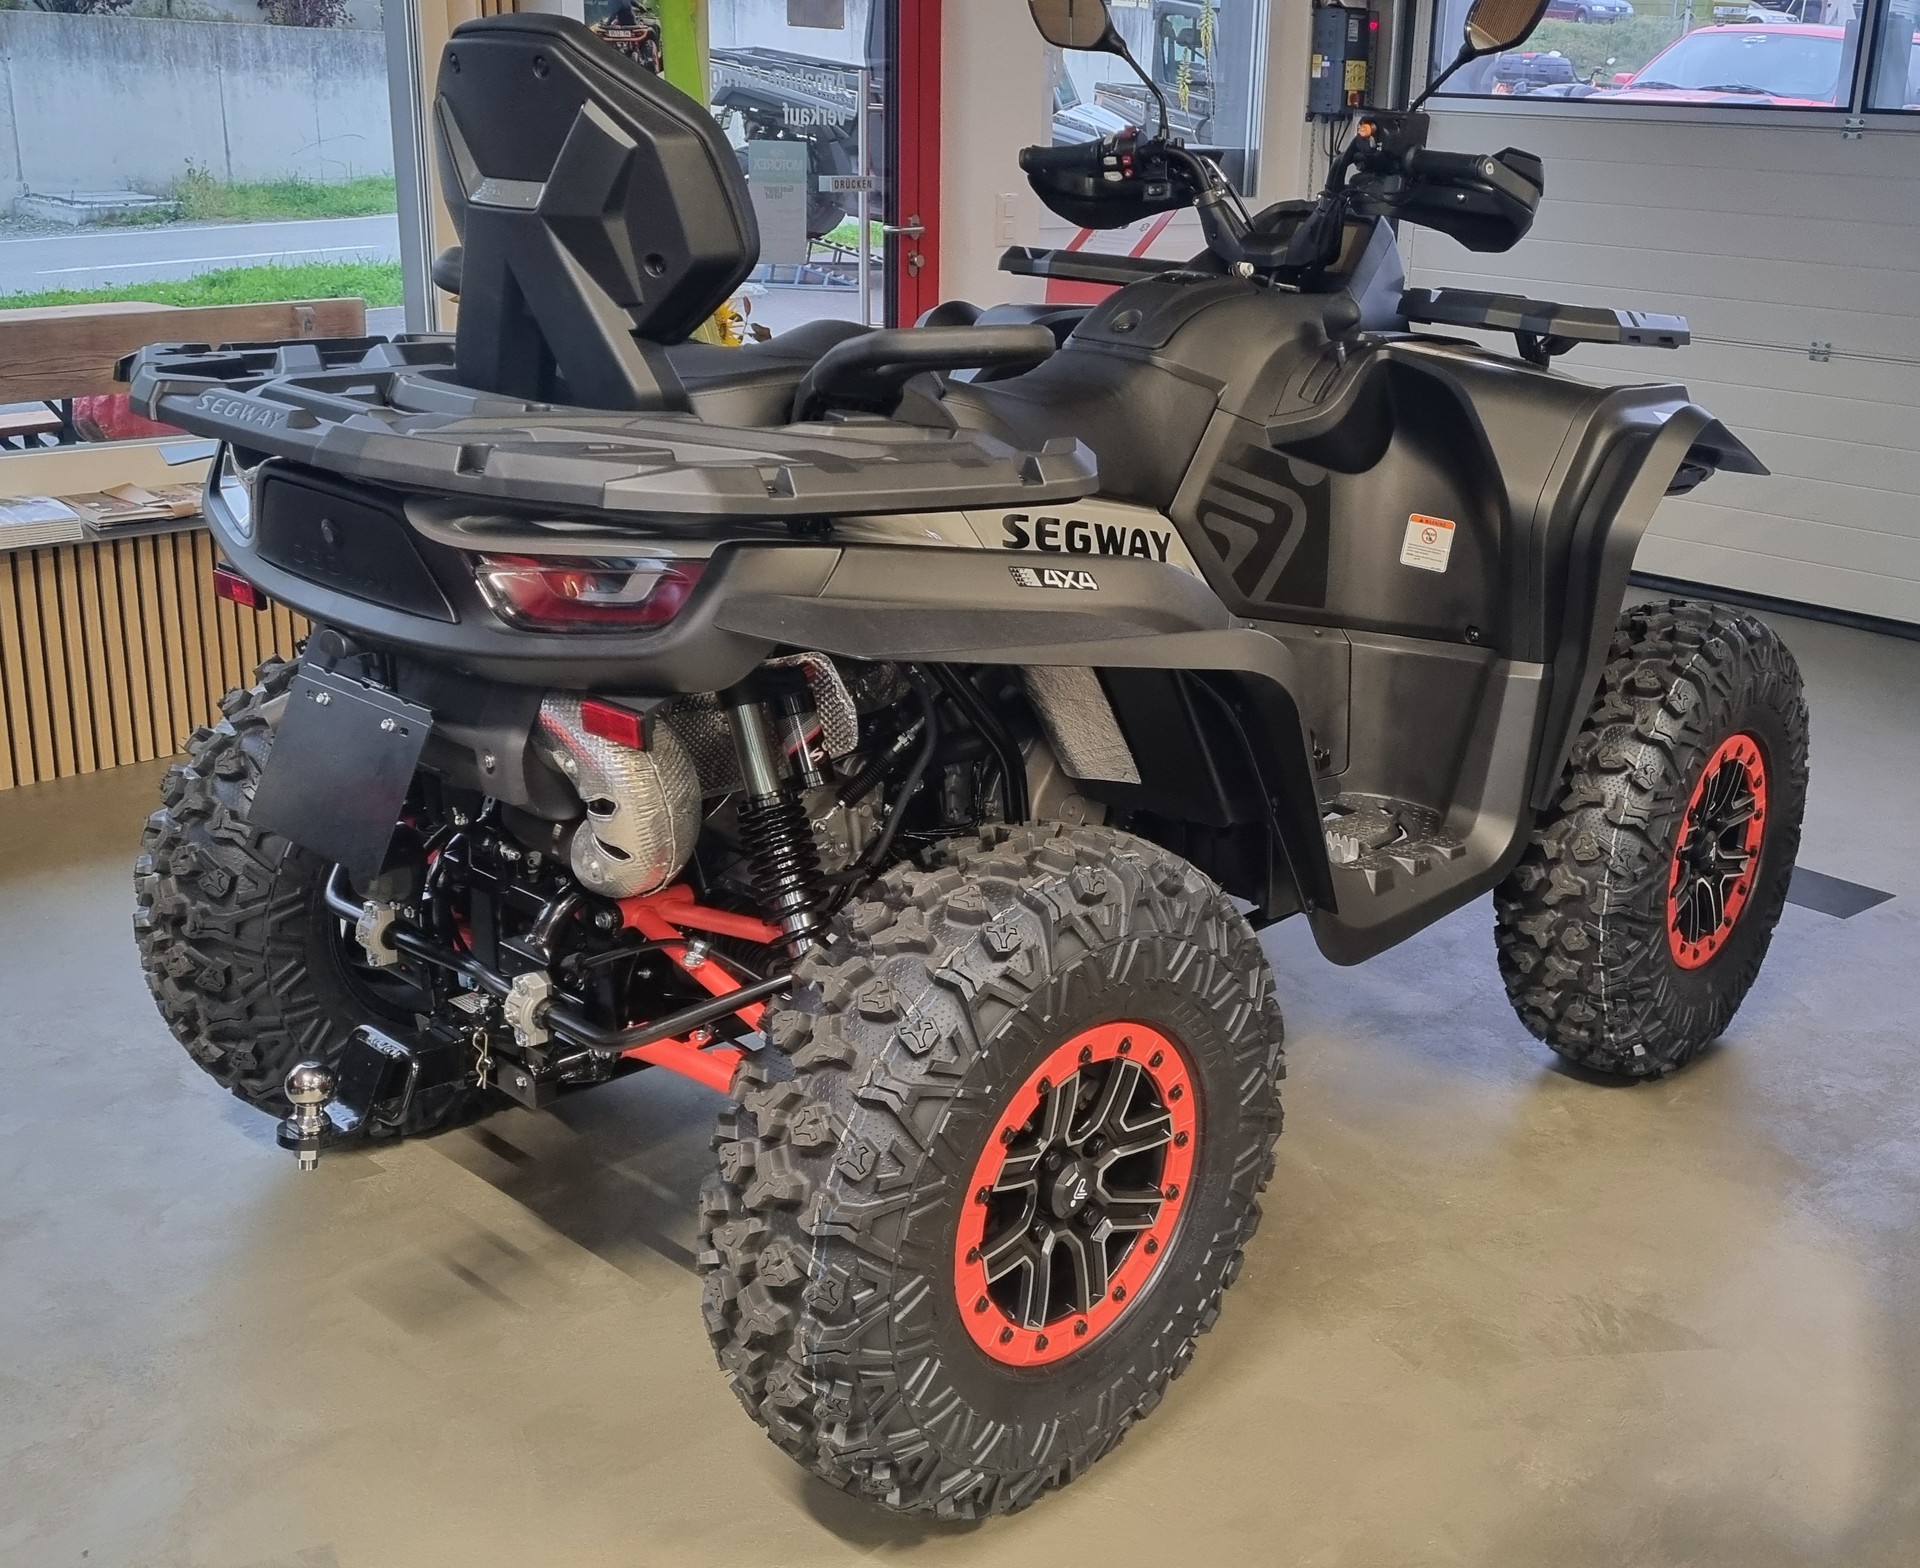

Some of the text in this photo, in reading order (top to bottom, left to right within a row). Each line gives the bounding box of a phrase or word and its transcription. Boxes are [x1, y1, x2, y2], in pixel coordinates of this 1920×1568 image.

[834, 177, 872, 189] DRÜCKEN
[197, 395, 286, 428] SEGWAY
[1002, 513, 1171, 564] SEGWAY
